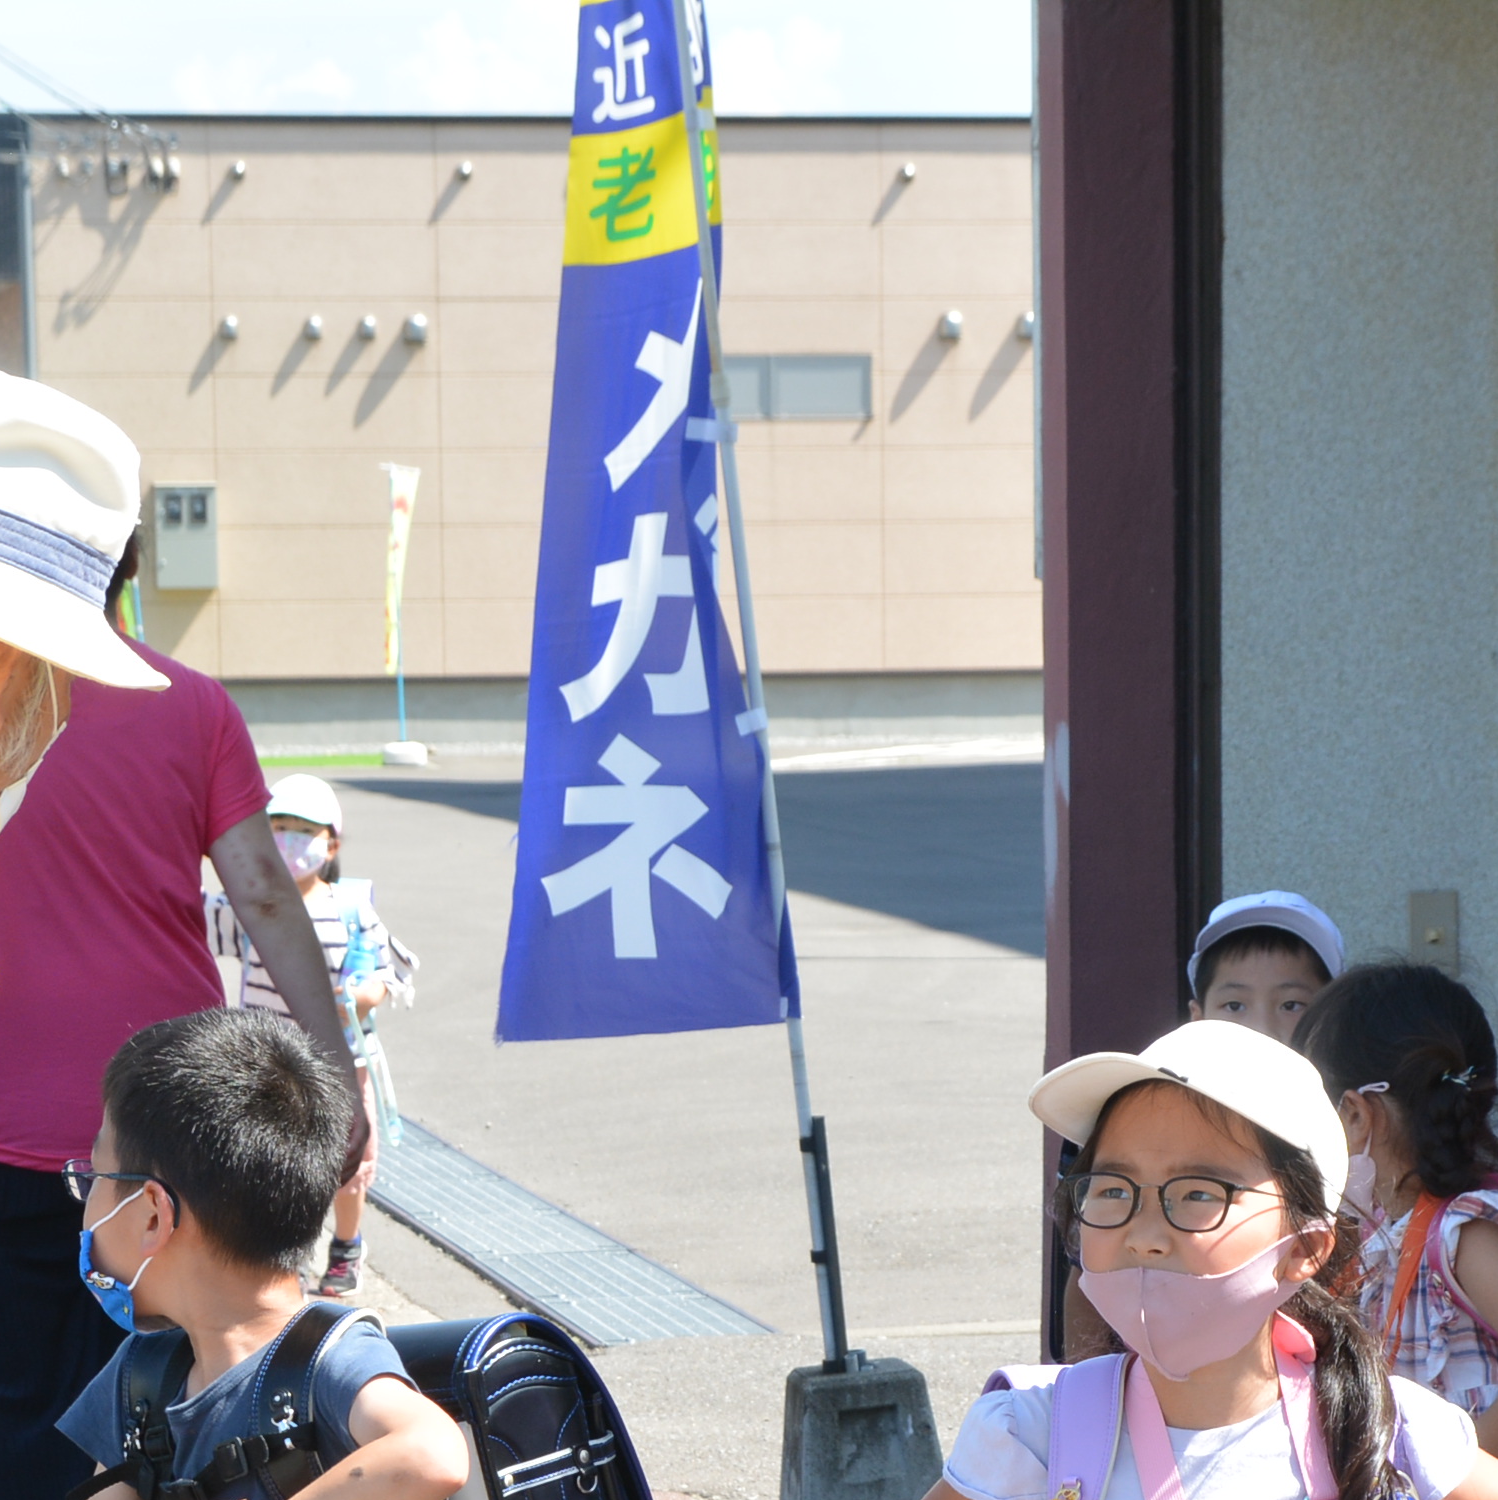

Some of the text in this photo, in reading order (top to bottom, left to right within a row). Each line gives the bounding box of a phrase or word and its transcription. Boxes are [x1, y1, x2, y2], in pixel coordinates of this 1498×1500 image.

[591, 10, 657, 125] 近
[590, 146, 657, 244] 老
[541, 275, 734, 960] メガネ
